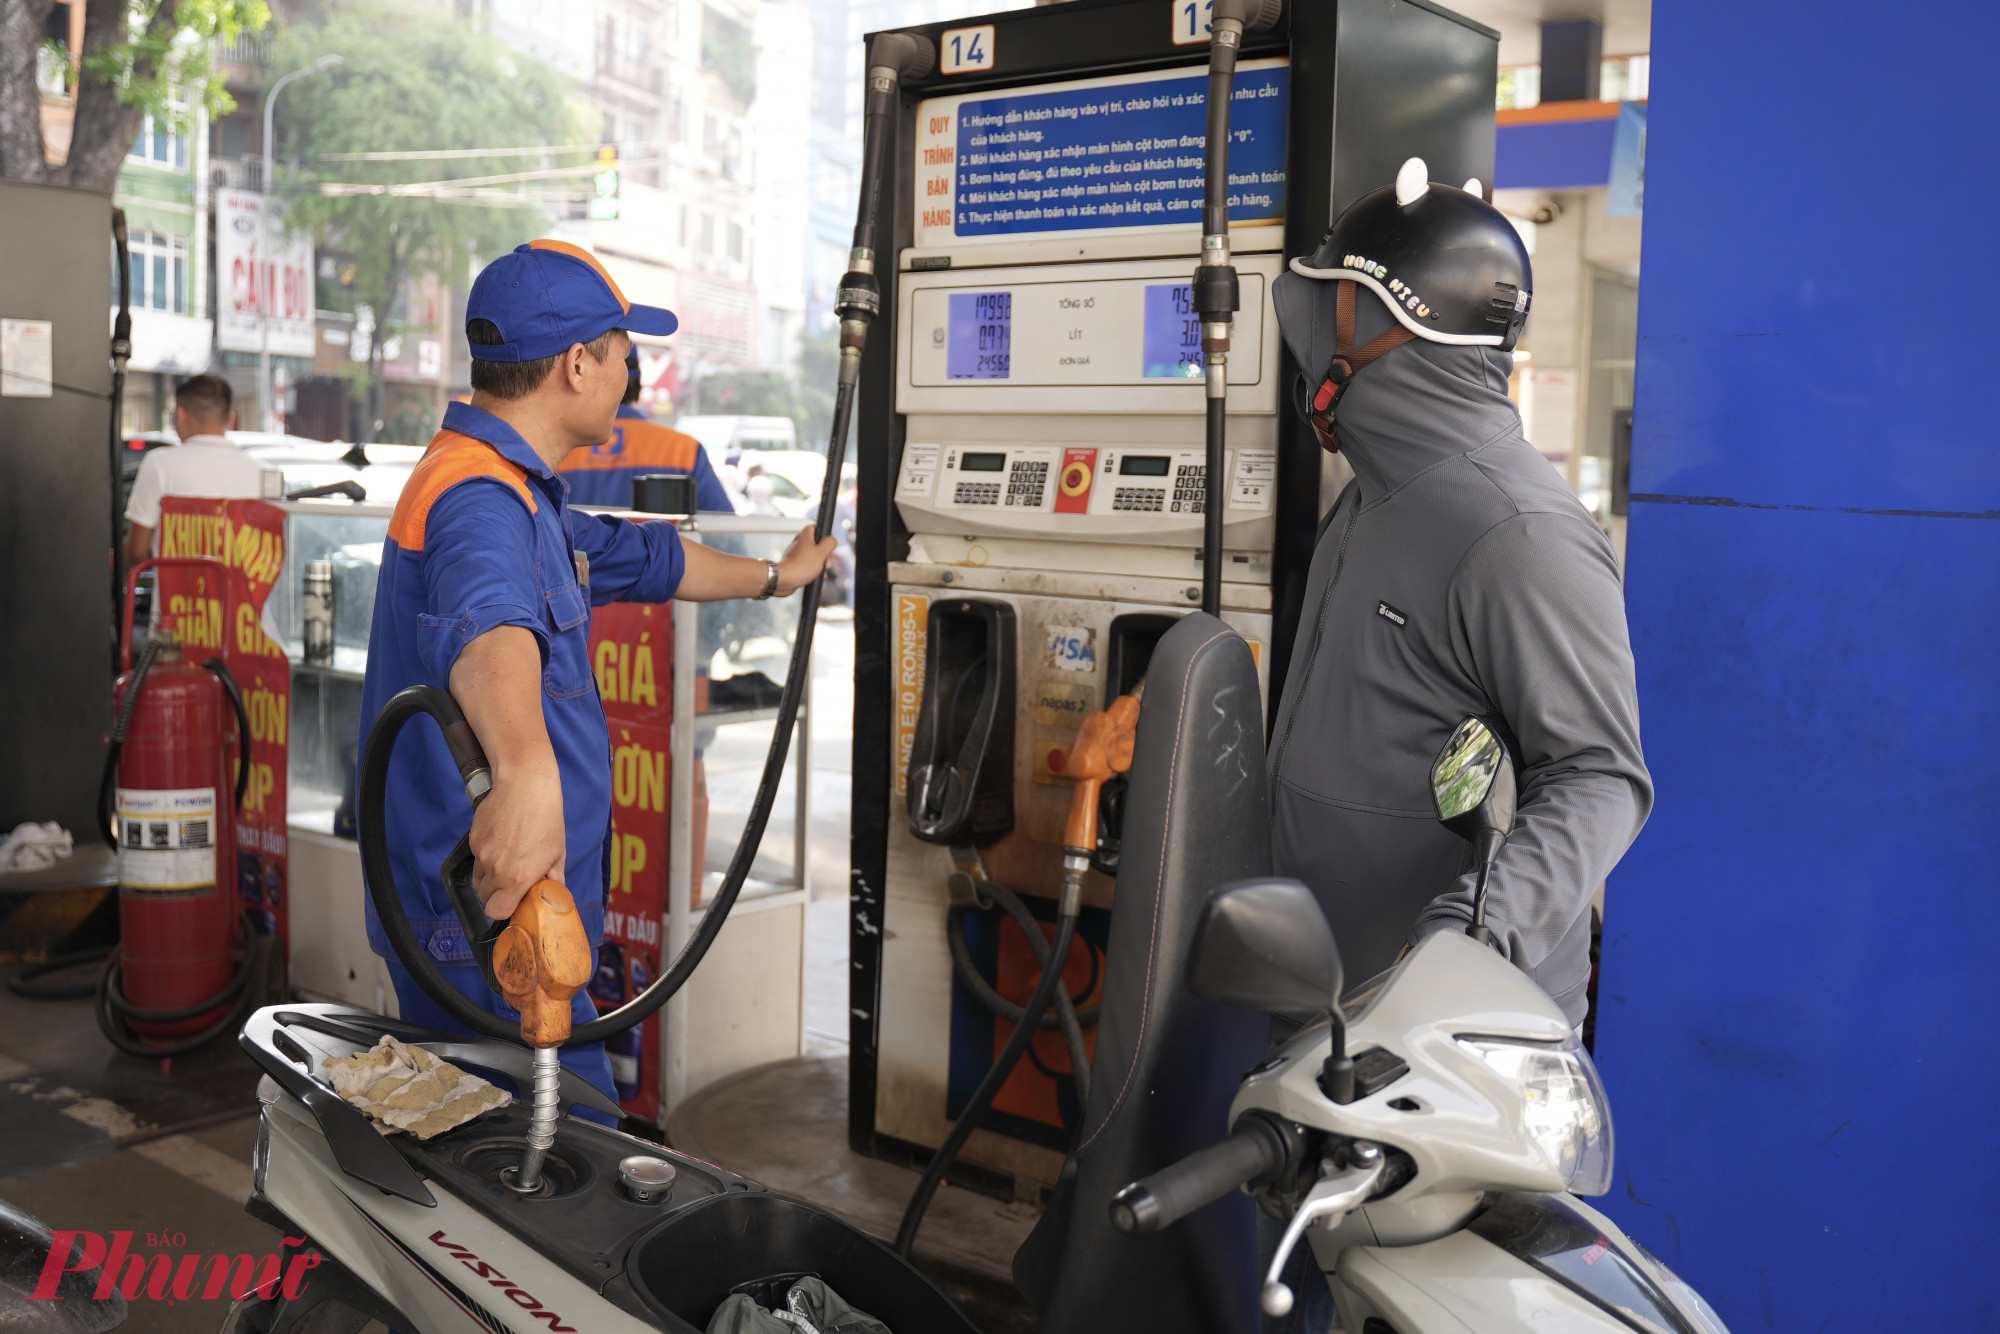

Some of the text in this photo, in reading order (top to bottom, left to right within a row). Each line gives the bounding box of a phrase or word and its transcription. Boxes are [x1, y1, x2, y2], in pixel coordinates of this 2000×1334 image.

[951, 33, 984, 66] 14
[961, 117, 970, 128] 1.
[1023, 107, 1052, 121] khách
[1053, 105, 1079, 120] hàng
[1079, 102, 1098, 115] vào
[1099, 100, 1109, 116] vị
[1126, 97, 1151, 112] chào
[1171, 93, 1184, 106] và
[1186, 92, 1205, 105] xác
[1235, 88, 1256, 100] nhu
[929, 116, 950, 136] QUY
[970, 129, 1044, 147] của khách hàng.
[924, 145, 954, 166] TRÌNH
[960, 155, 969, 167] 2.
[989, 150, 1017, 163] khách
[1018, 148, 1042, 162] hàng
[1043, 147, 1061, 159] xác
[1062, 144, 1086, 159] nhận
[1088, 142, 1110, 154] màn
[1111, 139, 1133, 153] hình
[1135, 138, 1152, 153] cột
[1154, 136, 1177, 149] bơm
[1179, 135, 1206, 148] đang
[927, 175, 949, 196] BÁN
[960, 174, 969, 186] 3.
[993, 171, 1016, 184] hàng
[1060, 165, 1082, 177] theo
[1083, 164, 1102, 178] yêu
[1123, 159, 1142, 173] của
[1144, 157, 1174, 171] khách
[1177, 155, 1206, 169] hàng.
[958, 193, 968, 205] 4.
[988, 189, 1016, 203] khách
[1017, 187, 1041, 202] hàng
[1042, 186, 1060, 198] xác
[1061, 184, 1085, 199] nhận
[1086, 182, 1108, 195] màn
[1110, 181, 1132, 194] hình
[1133, 179, 1150, 194] cột
[1152, 178, 1176, 191] bơm
[1228, 173, 1259, 185] thanh
[1261, 169, 1286, 183] toán
[923, 207, 951, 228] HÀNG
[958, 212, 967, 224] 5.
[994, 208, 1014, 223] hiện
[1015, 207, 1042, 220] thanh
[1043, 205, 1064, 219] toán
[1066, 204, 1078, 216] và
[1080, 203, 1097, 216] xác
[1099, 201, 1124, 216] nhận
[1243, 193, 1273, 207] hàng.
[1069, 329, 1083, 340] LÍT
[903, 599, 917, 687] RON95-V
[595, 632, 658, 707] GIÁ
[901, 692, 916, 727] E10
[1040, 696, 1077, 712] napas
[428, 1230, 578, 1333] VISION
